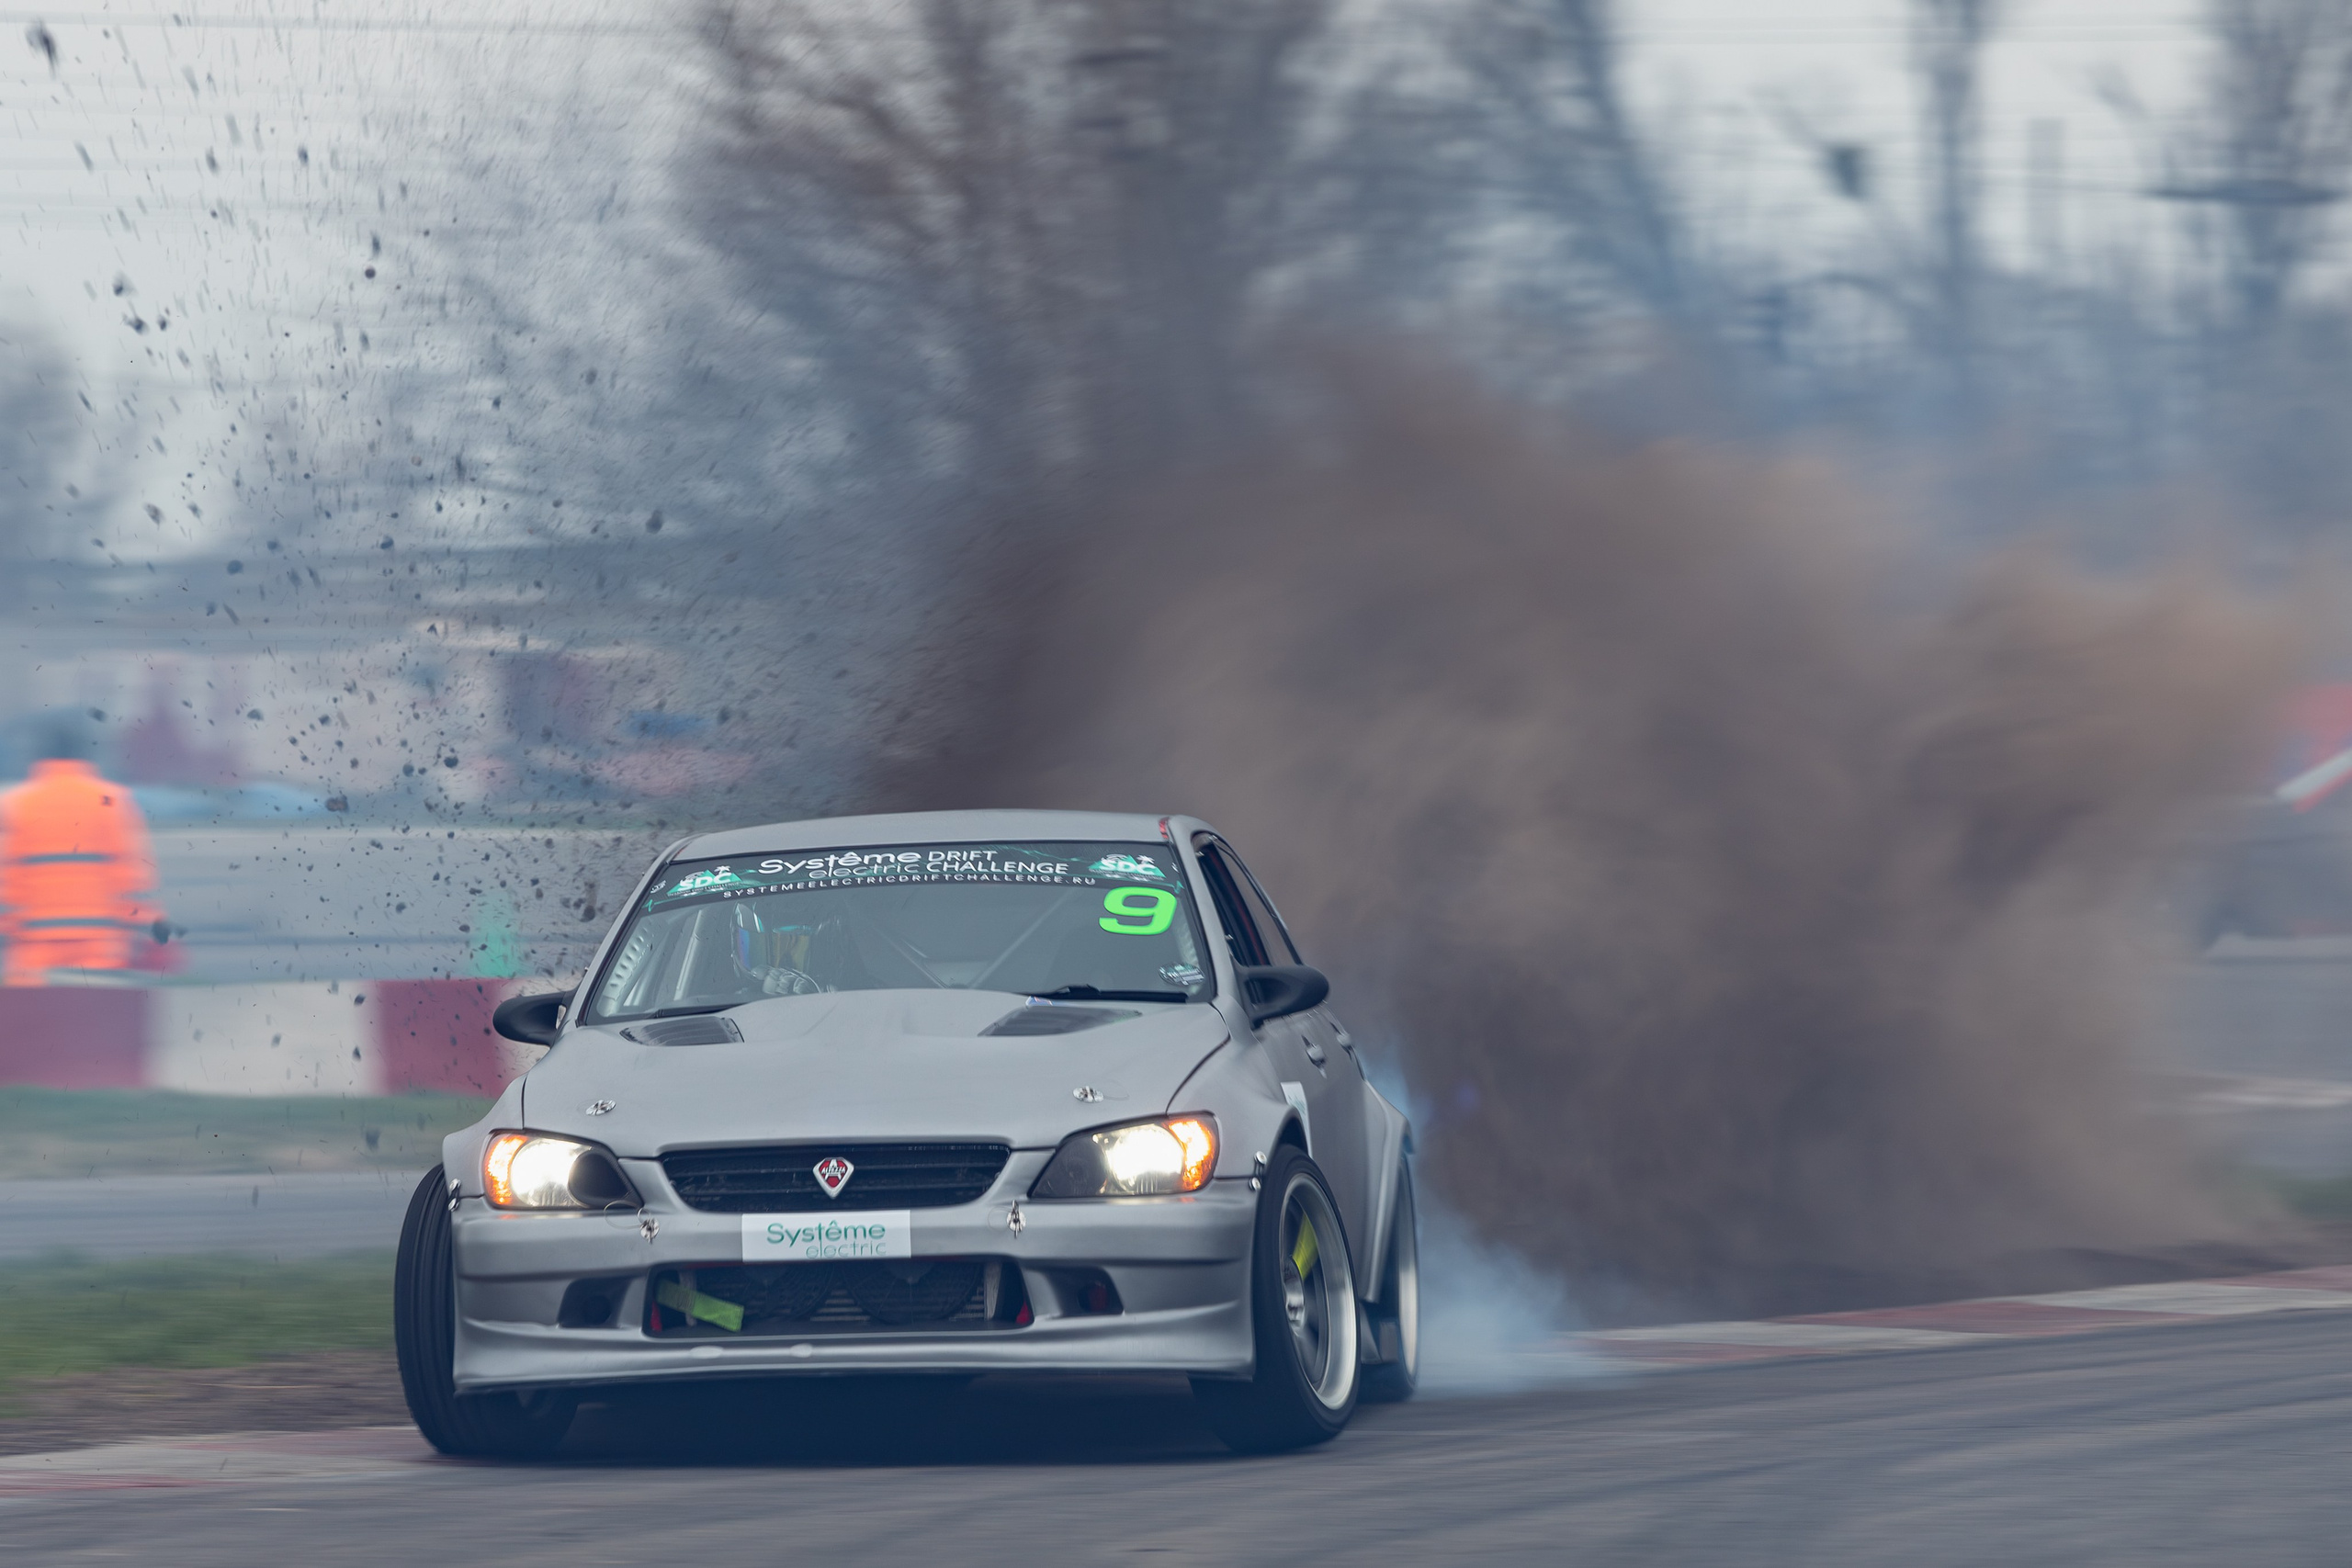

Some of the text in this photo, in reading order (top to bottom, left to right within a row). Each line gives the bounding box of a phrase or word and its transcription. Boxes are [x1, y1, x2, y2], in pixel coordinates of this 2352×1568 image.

[758, 851, 998, 874] Systême DRIFT
[808, 861, 1069, 879] electric CHALLENGE
[1099, 858, 1157, 875] SDC
[677, 872, 732, 891] SDC
[723, 874, 1096, 898] SYSTEMEELECTRICDRIFTCHALLENGE.RU
[1099, 886, 1177, 935] 9
[766, 1219, 886, 1248] Systême
[805, 1241, 888, 1259] electric
